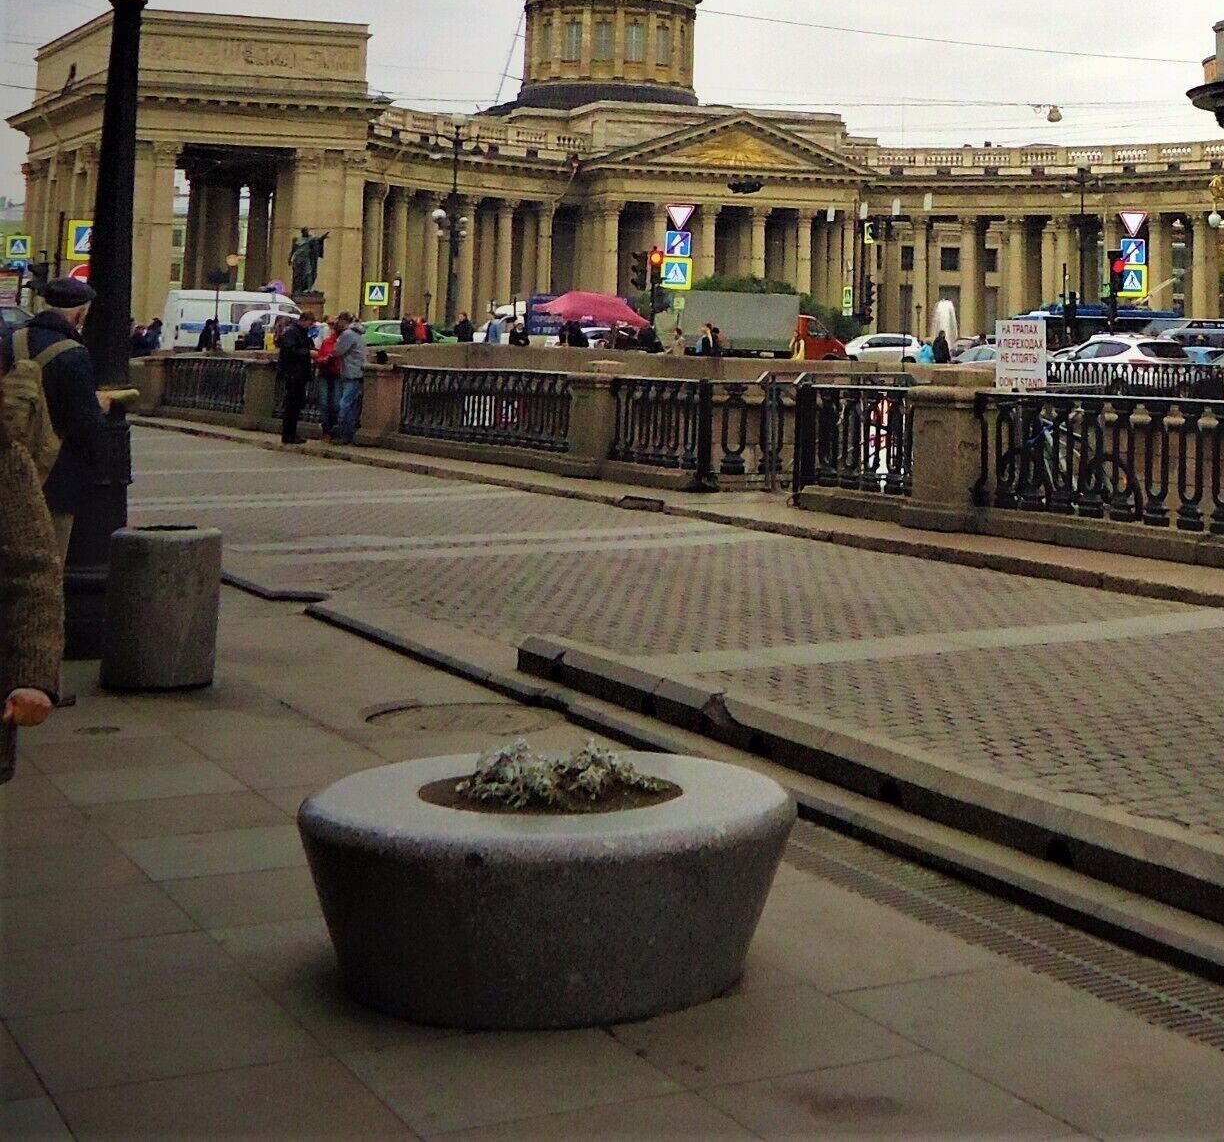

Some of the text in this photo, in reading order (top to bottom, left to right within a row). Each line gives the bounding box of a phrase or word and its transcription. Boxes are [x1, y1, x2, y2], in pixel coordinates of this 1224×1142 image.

[1002, 324, 1038, 334] НА ТРАПАХ
[1003, 339, 1043, 349] ПЕРЕХОДАХ
[1001, 353, 1009, 363] НЕ
[1020, 377, 1042, 388] STAND
